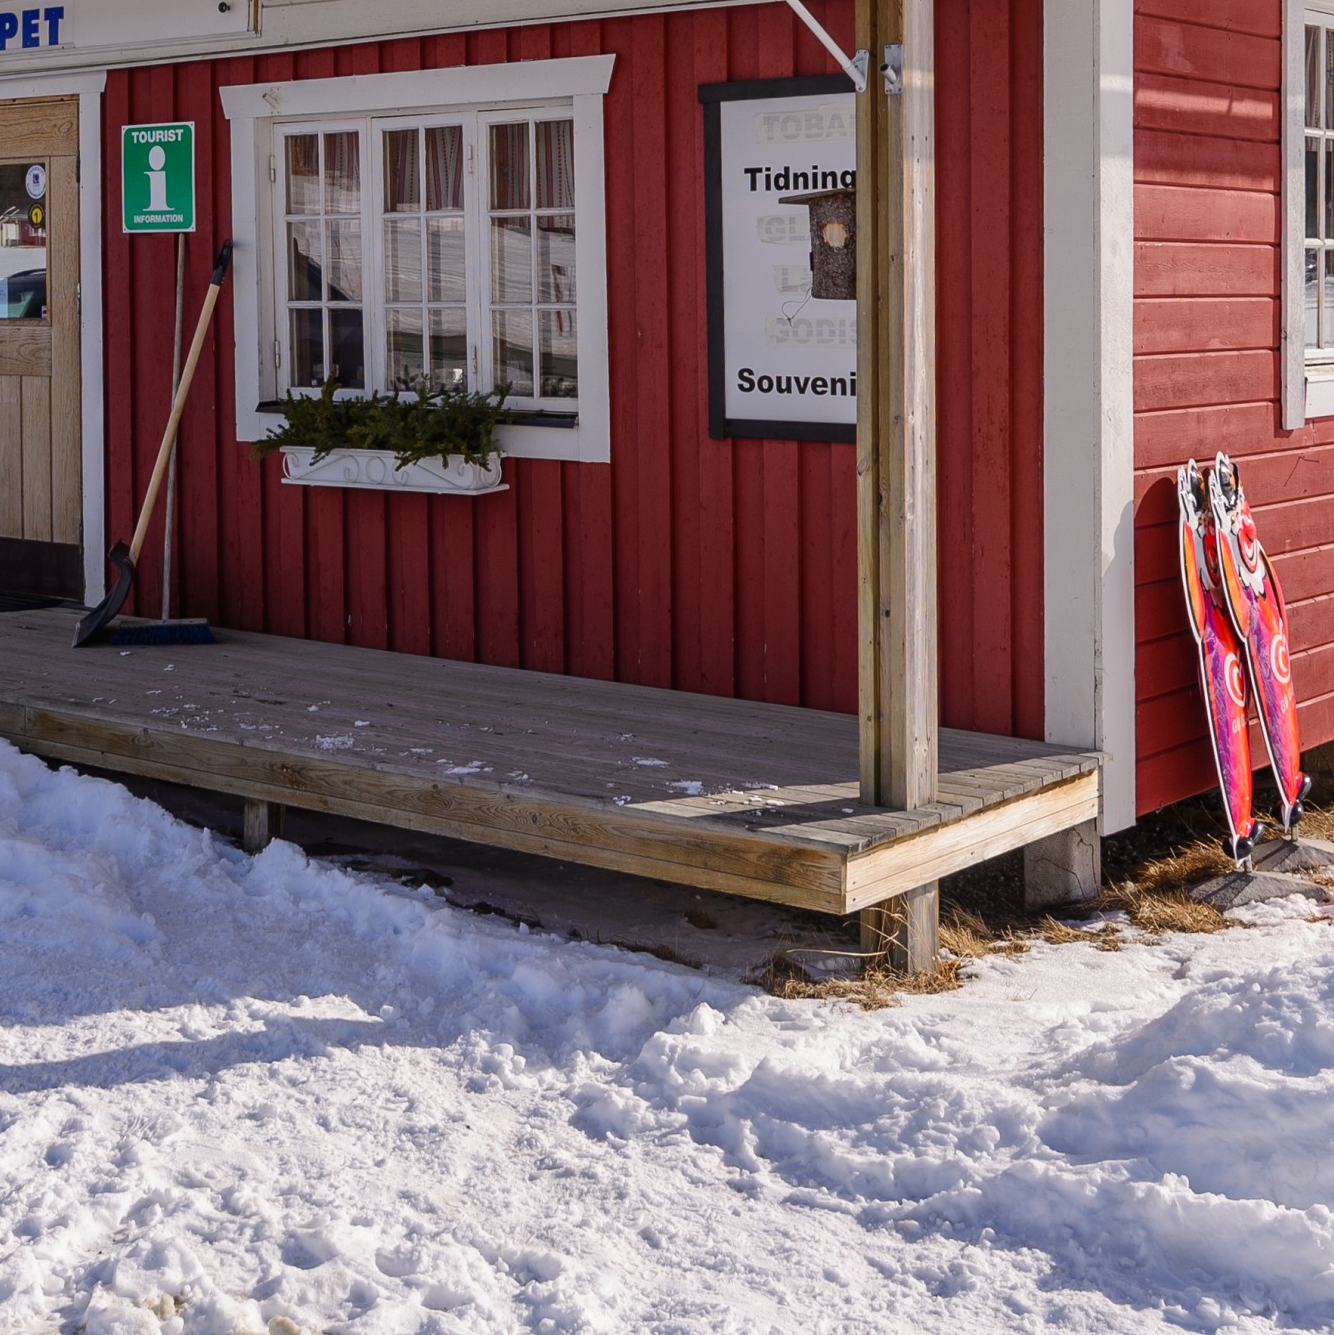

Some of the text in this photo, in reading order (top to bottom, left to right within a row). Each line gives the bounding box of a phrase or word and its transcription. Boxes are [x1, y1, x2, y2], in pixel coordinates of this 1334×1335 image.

[131, 128, 184, 144] TOURIST
[763, 111, 855, 141] TOBA
[744, 165, 856, 192] Tidning
[133, 213, 184, 225] INFORMATION
[736, 367, 856, 397] Souveni
